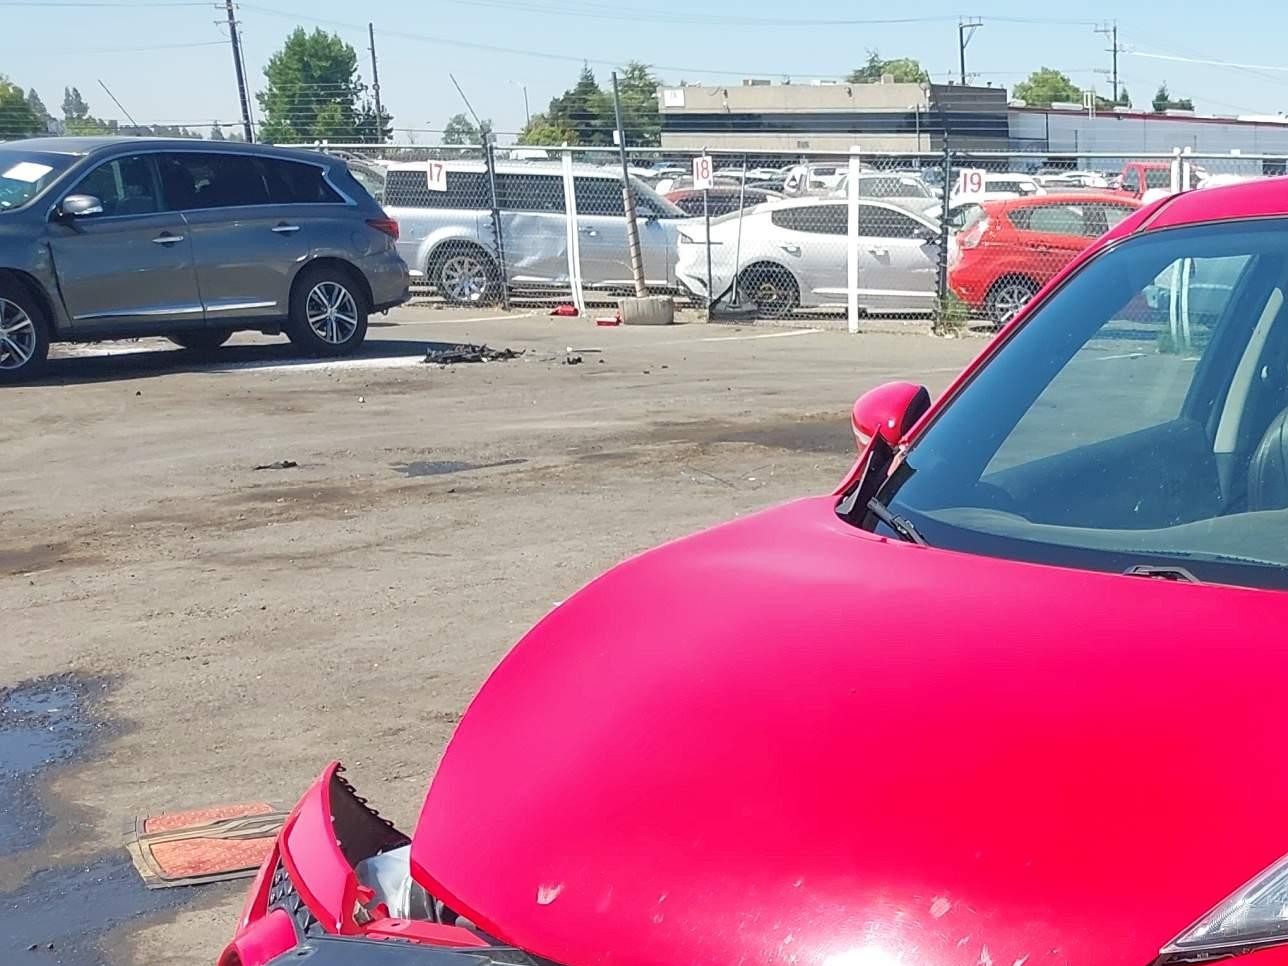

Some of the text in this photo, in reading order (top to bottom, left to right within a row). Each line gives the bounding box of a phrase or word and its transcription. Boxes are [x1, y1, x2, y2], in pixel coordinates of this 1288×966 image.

[429, 163, 443, 183] 17
[695, 159, 710, 181] 18
[963, 172, 982, 193] 19
